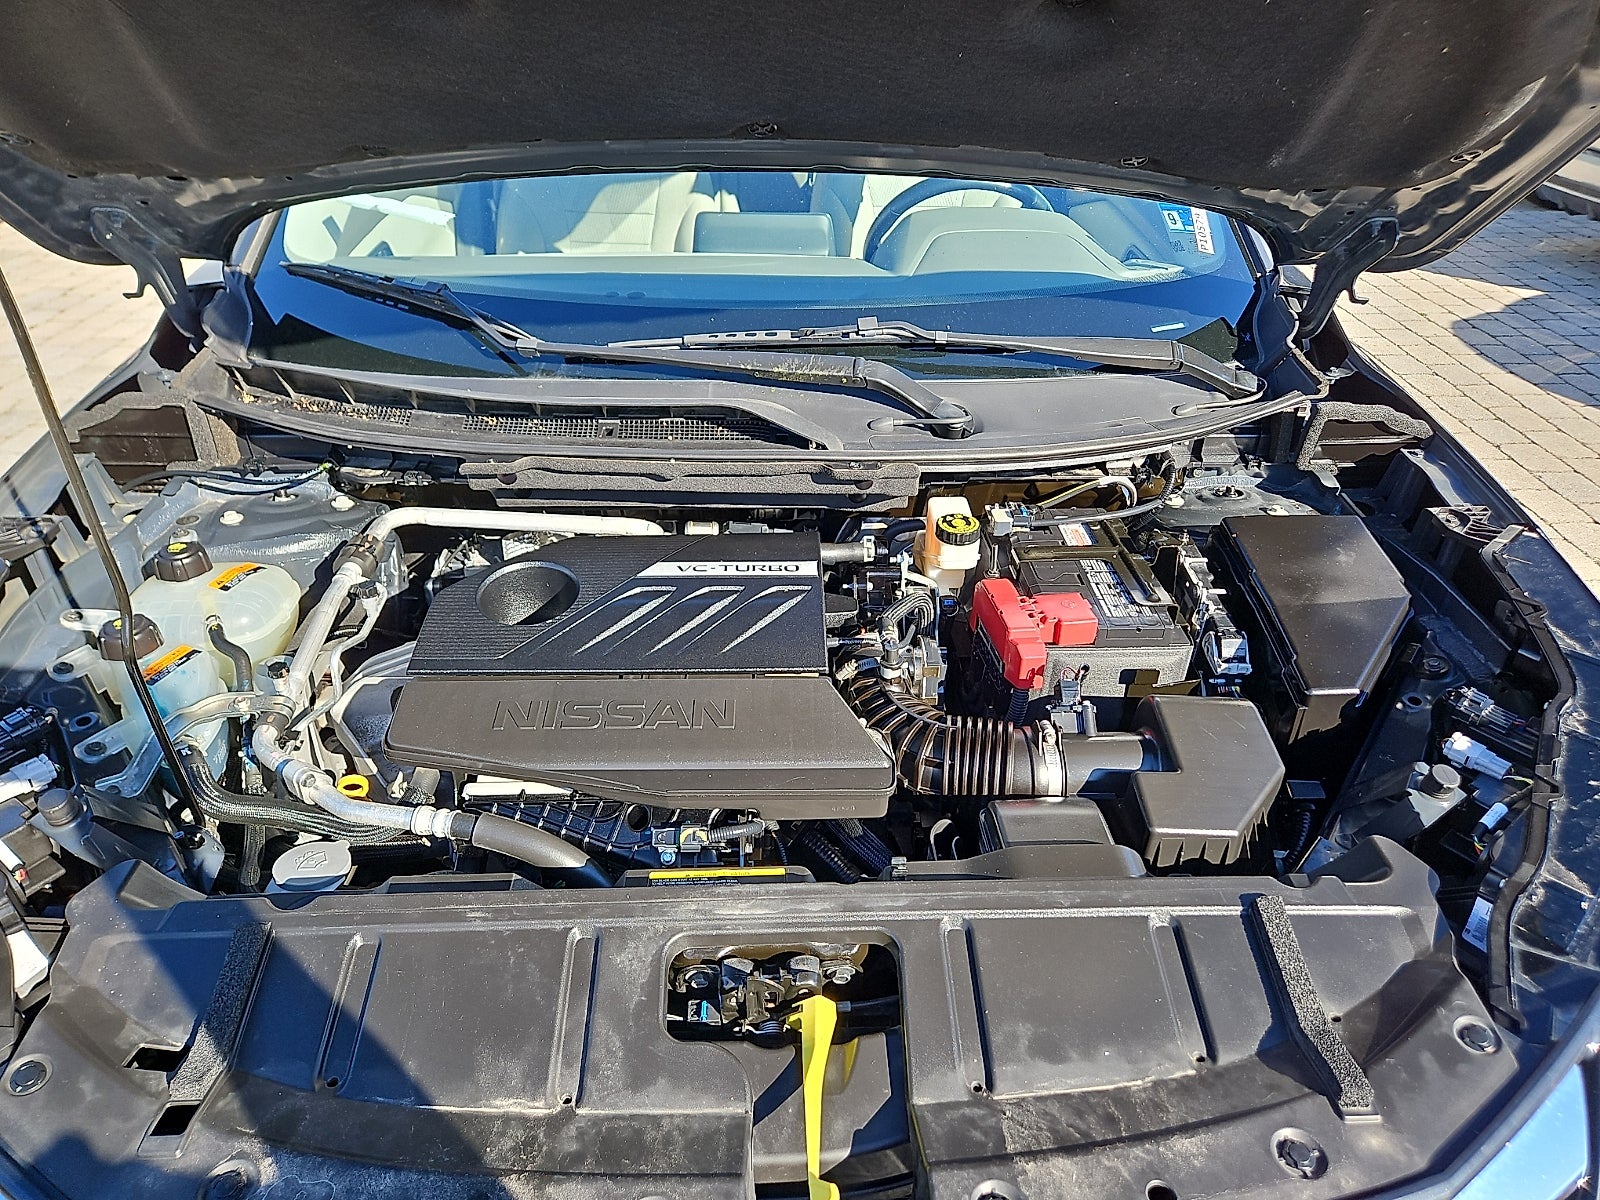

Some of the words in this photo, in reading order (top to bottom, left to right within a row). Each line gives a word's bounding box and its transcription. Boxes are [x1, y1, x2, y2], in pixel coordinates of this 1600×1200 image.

[1167, 212, 1177, 225] 9
[677, 564, 800, 572] VC-TURBO
[492, 699, 736, 730] NISSAN
